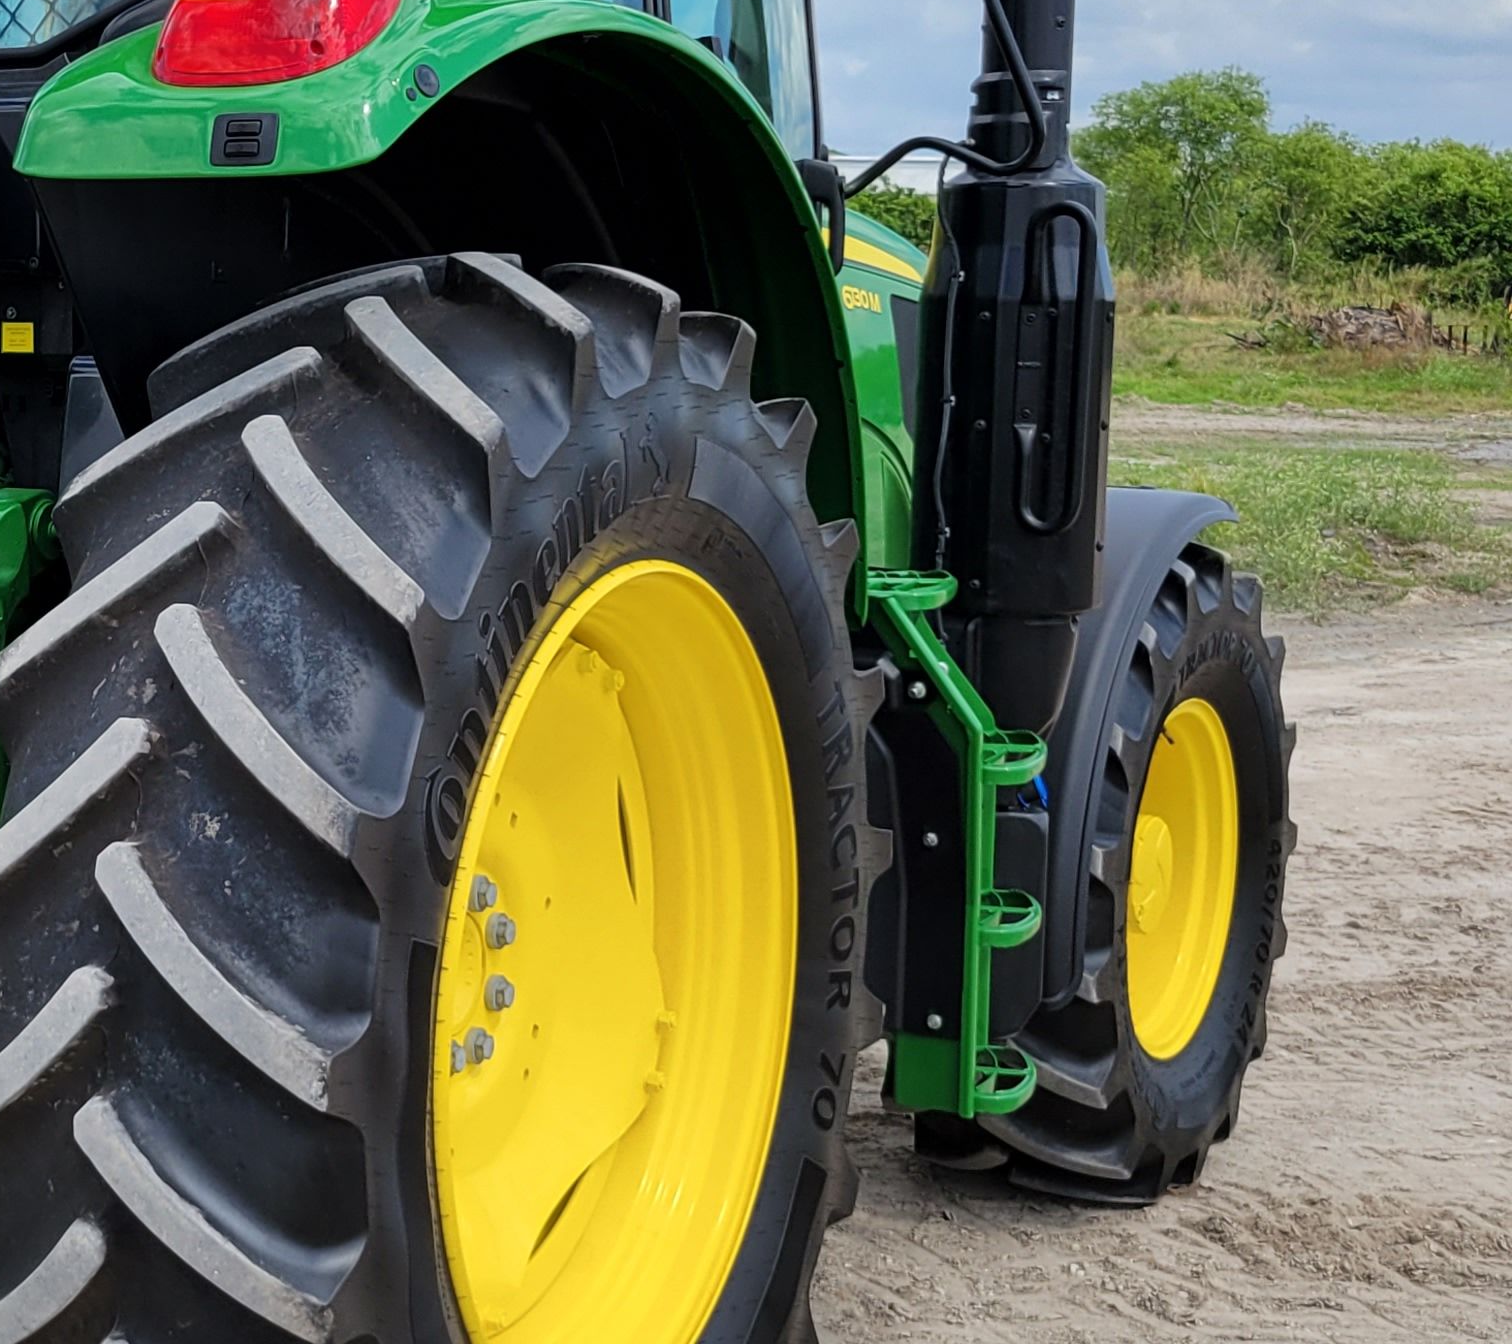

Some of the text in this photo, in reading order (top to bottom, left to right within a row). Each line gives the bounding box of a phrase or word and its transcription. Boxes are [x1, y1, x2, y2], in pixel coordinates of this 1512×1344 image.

[422, 427, 629, 888] Continental
[811, 678, 859, 1133] TRACTOR 70
[1236, 838, 1283, 1047] 420/70 R 24
